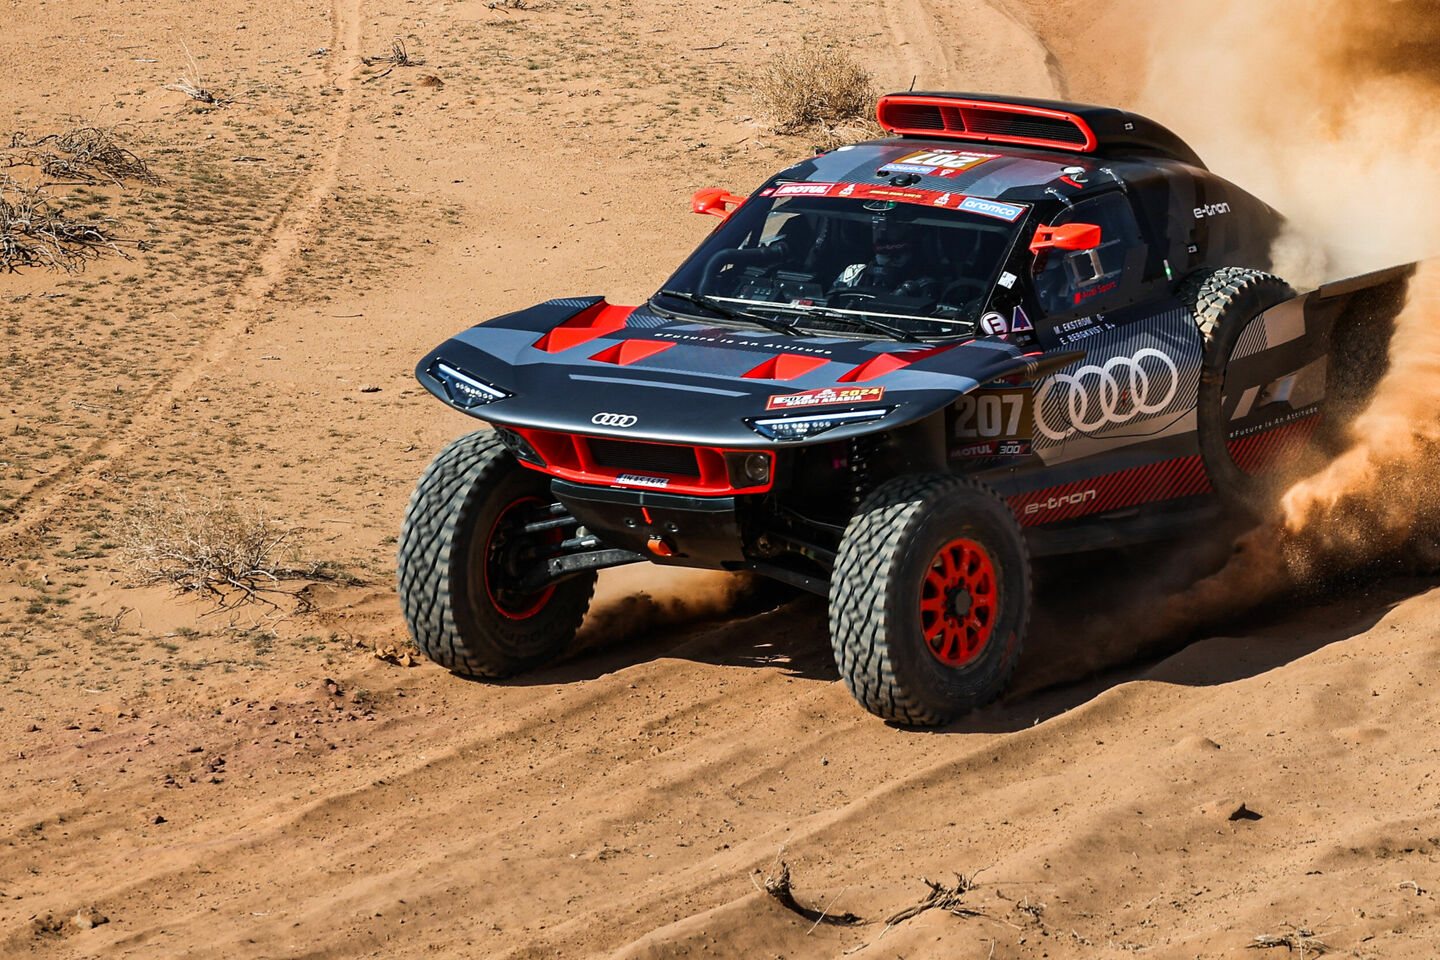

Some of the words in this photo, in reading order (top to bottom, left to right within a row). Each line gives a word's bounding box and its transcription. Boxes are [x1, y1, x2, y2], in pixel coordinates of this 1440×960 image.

[901, 152, 980, 169] 207
[777, 185, 828, 194] MOTUL
[964, 200, 1016, 216] aramco
[1193, 201, 1231, 219] e-tron
[987, 316, 1005, 335] E
[821, 395, 862, 403] ARABIA
[839, 388, 880, 397] 2024
[954, 393, 1024, 438] 207
[951, 445, 993, 457] MOTUL
[1024, 489, 1096, 515] e-tron
